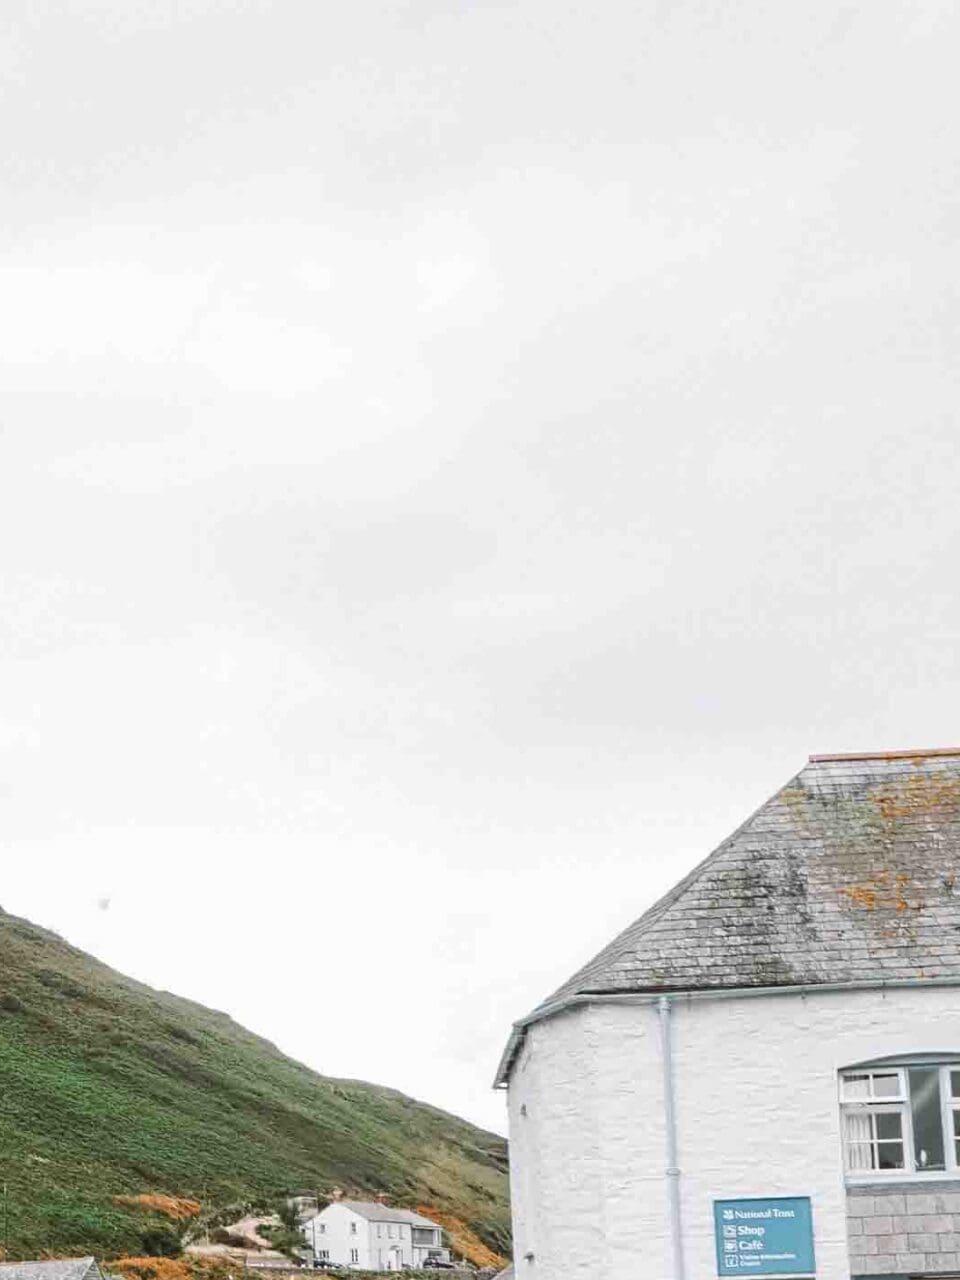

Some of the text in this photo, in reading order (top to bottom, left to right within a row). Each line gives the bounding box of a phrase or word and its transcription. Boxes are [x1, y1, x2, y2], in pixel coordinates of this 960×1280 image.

[735, 1208, 795, 1219] National Trust
[737, 1225, 765, 1236] Shop
[739, 1240, 765, 1250] Café
